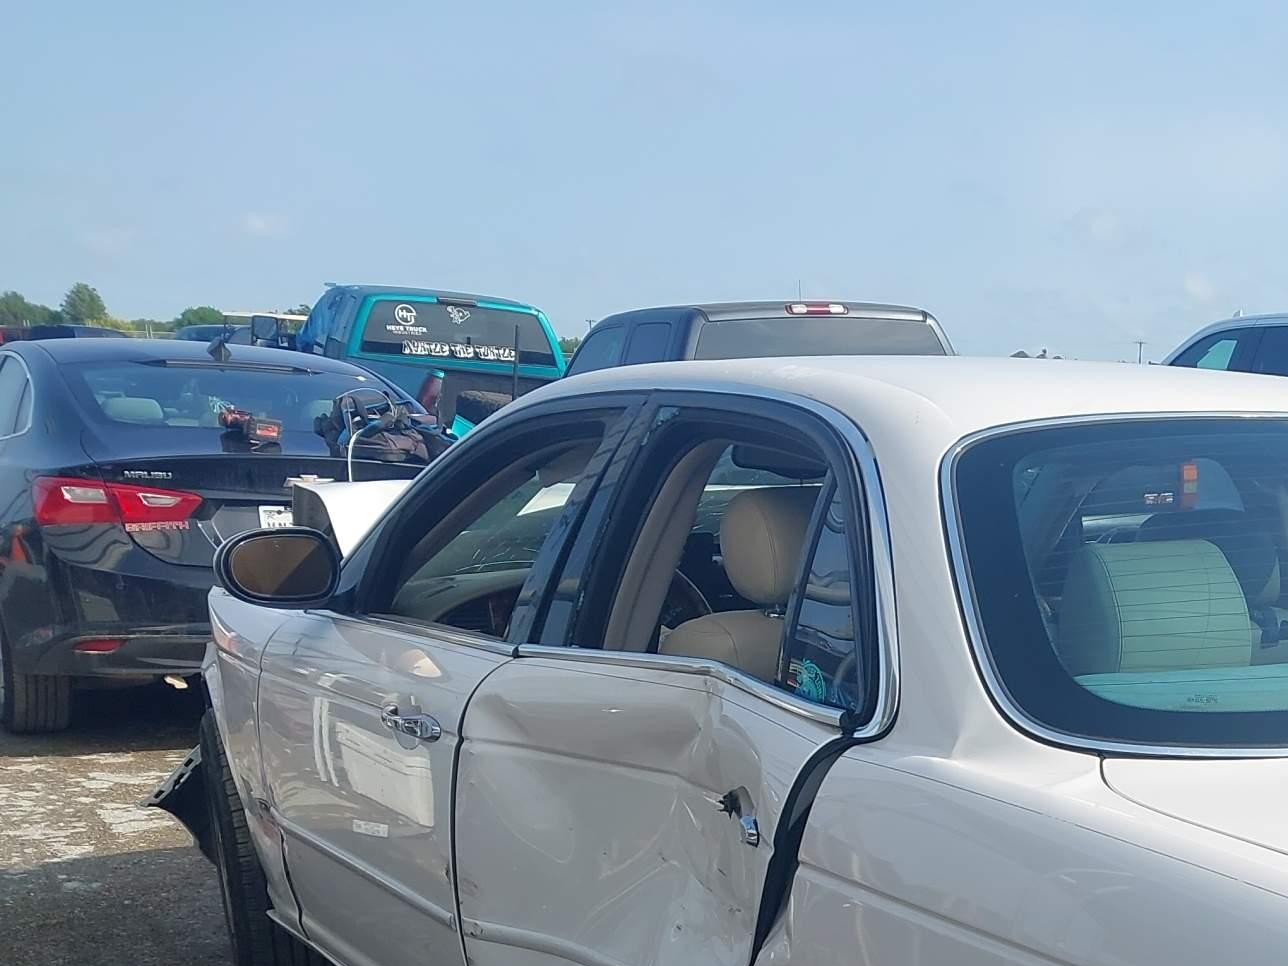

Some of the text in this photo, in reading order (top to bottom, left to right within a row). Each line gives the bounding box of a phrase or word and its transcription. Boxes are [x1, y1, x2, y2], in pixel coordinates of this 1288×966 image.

[450, 343, 475, 358] THE
[475, 345, 515, 361] TURTLE
[123, 470, 173, 480] MALIBU
[125, 520, 190, 533] GRIFFITH
